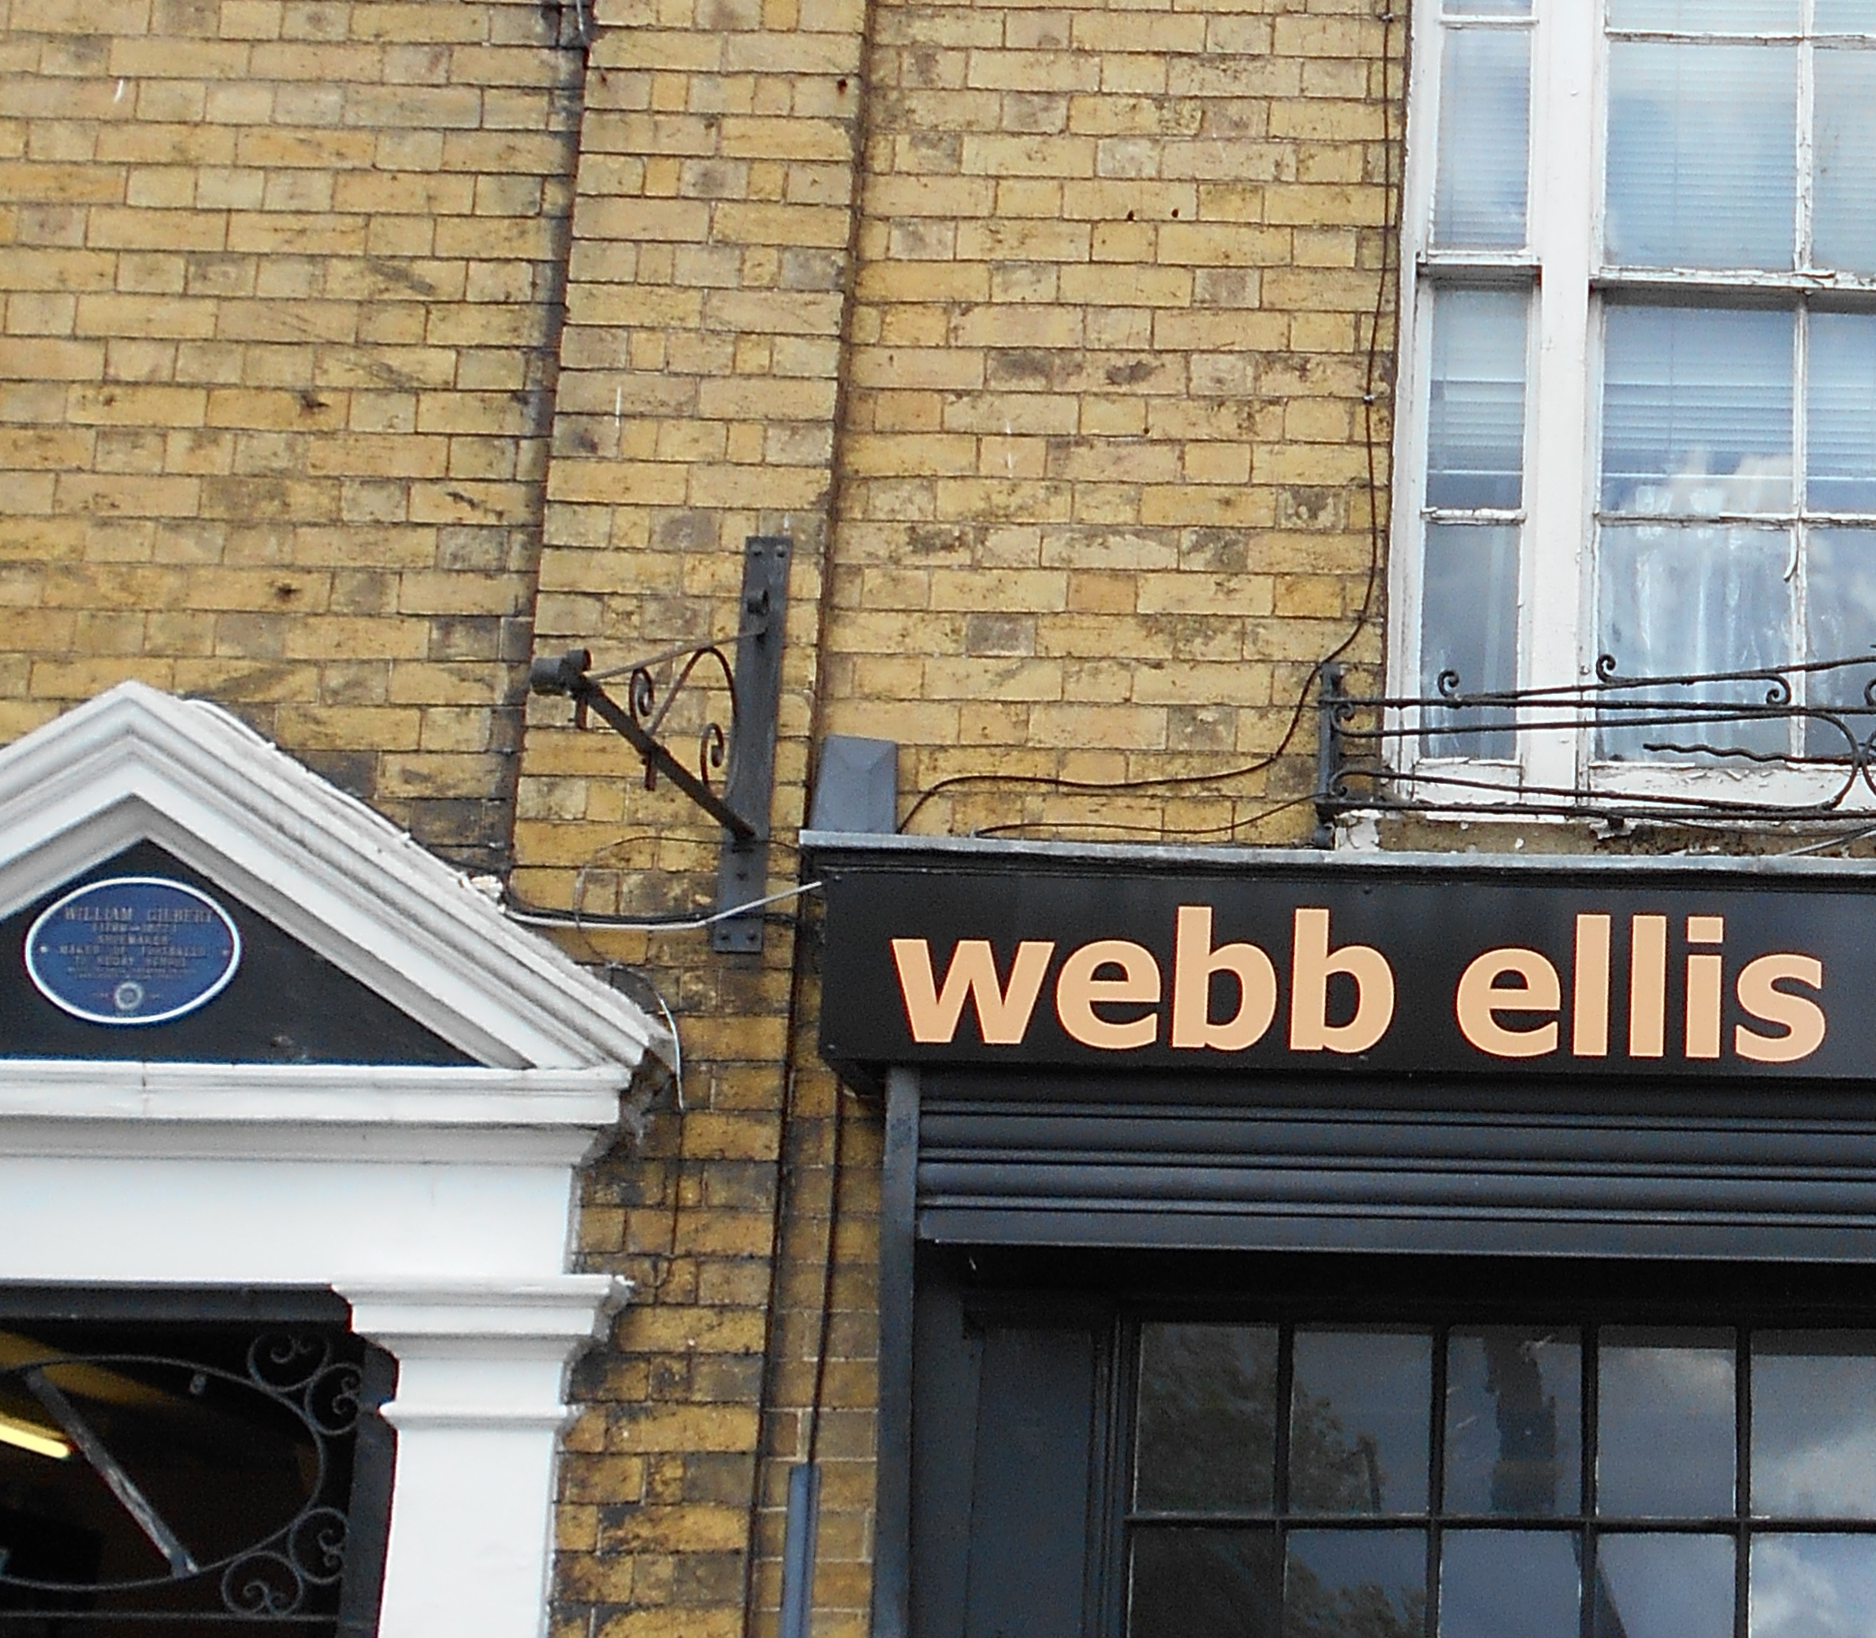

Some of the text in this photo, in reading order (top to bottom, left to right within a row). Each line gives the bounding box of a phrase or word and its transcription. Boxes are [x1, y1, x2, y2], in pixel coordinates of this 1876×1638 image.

[64, 906, 133, 921] WILLIAM
[890, 905, 1396, 1054] webb
[1455, 913, 1827, 1063] ellis
